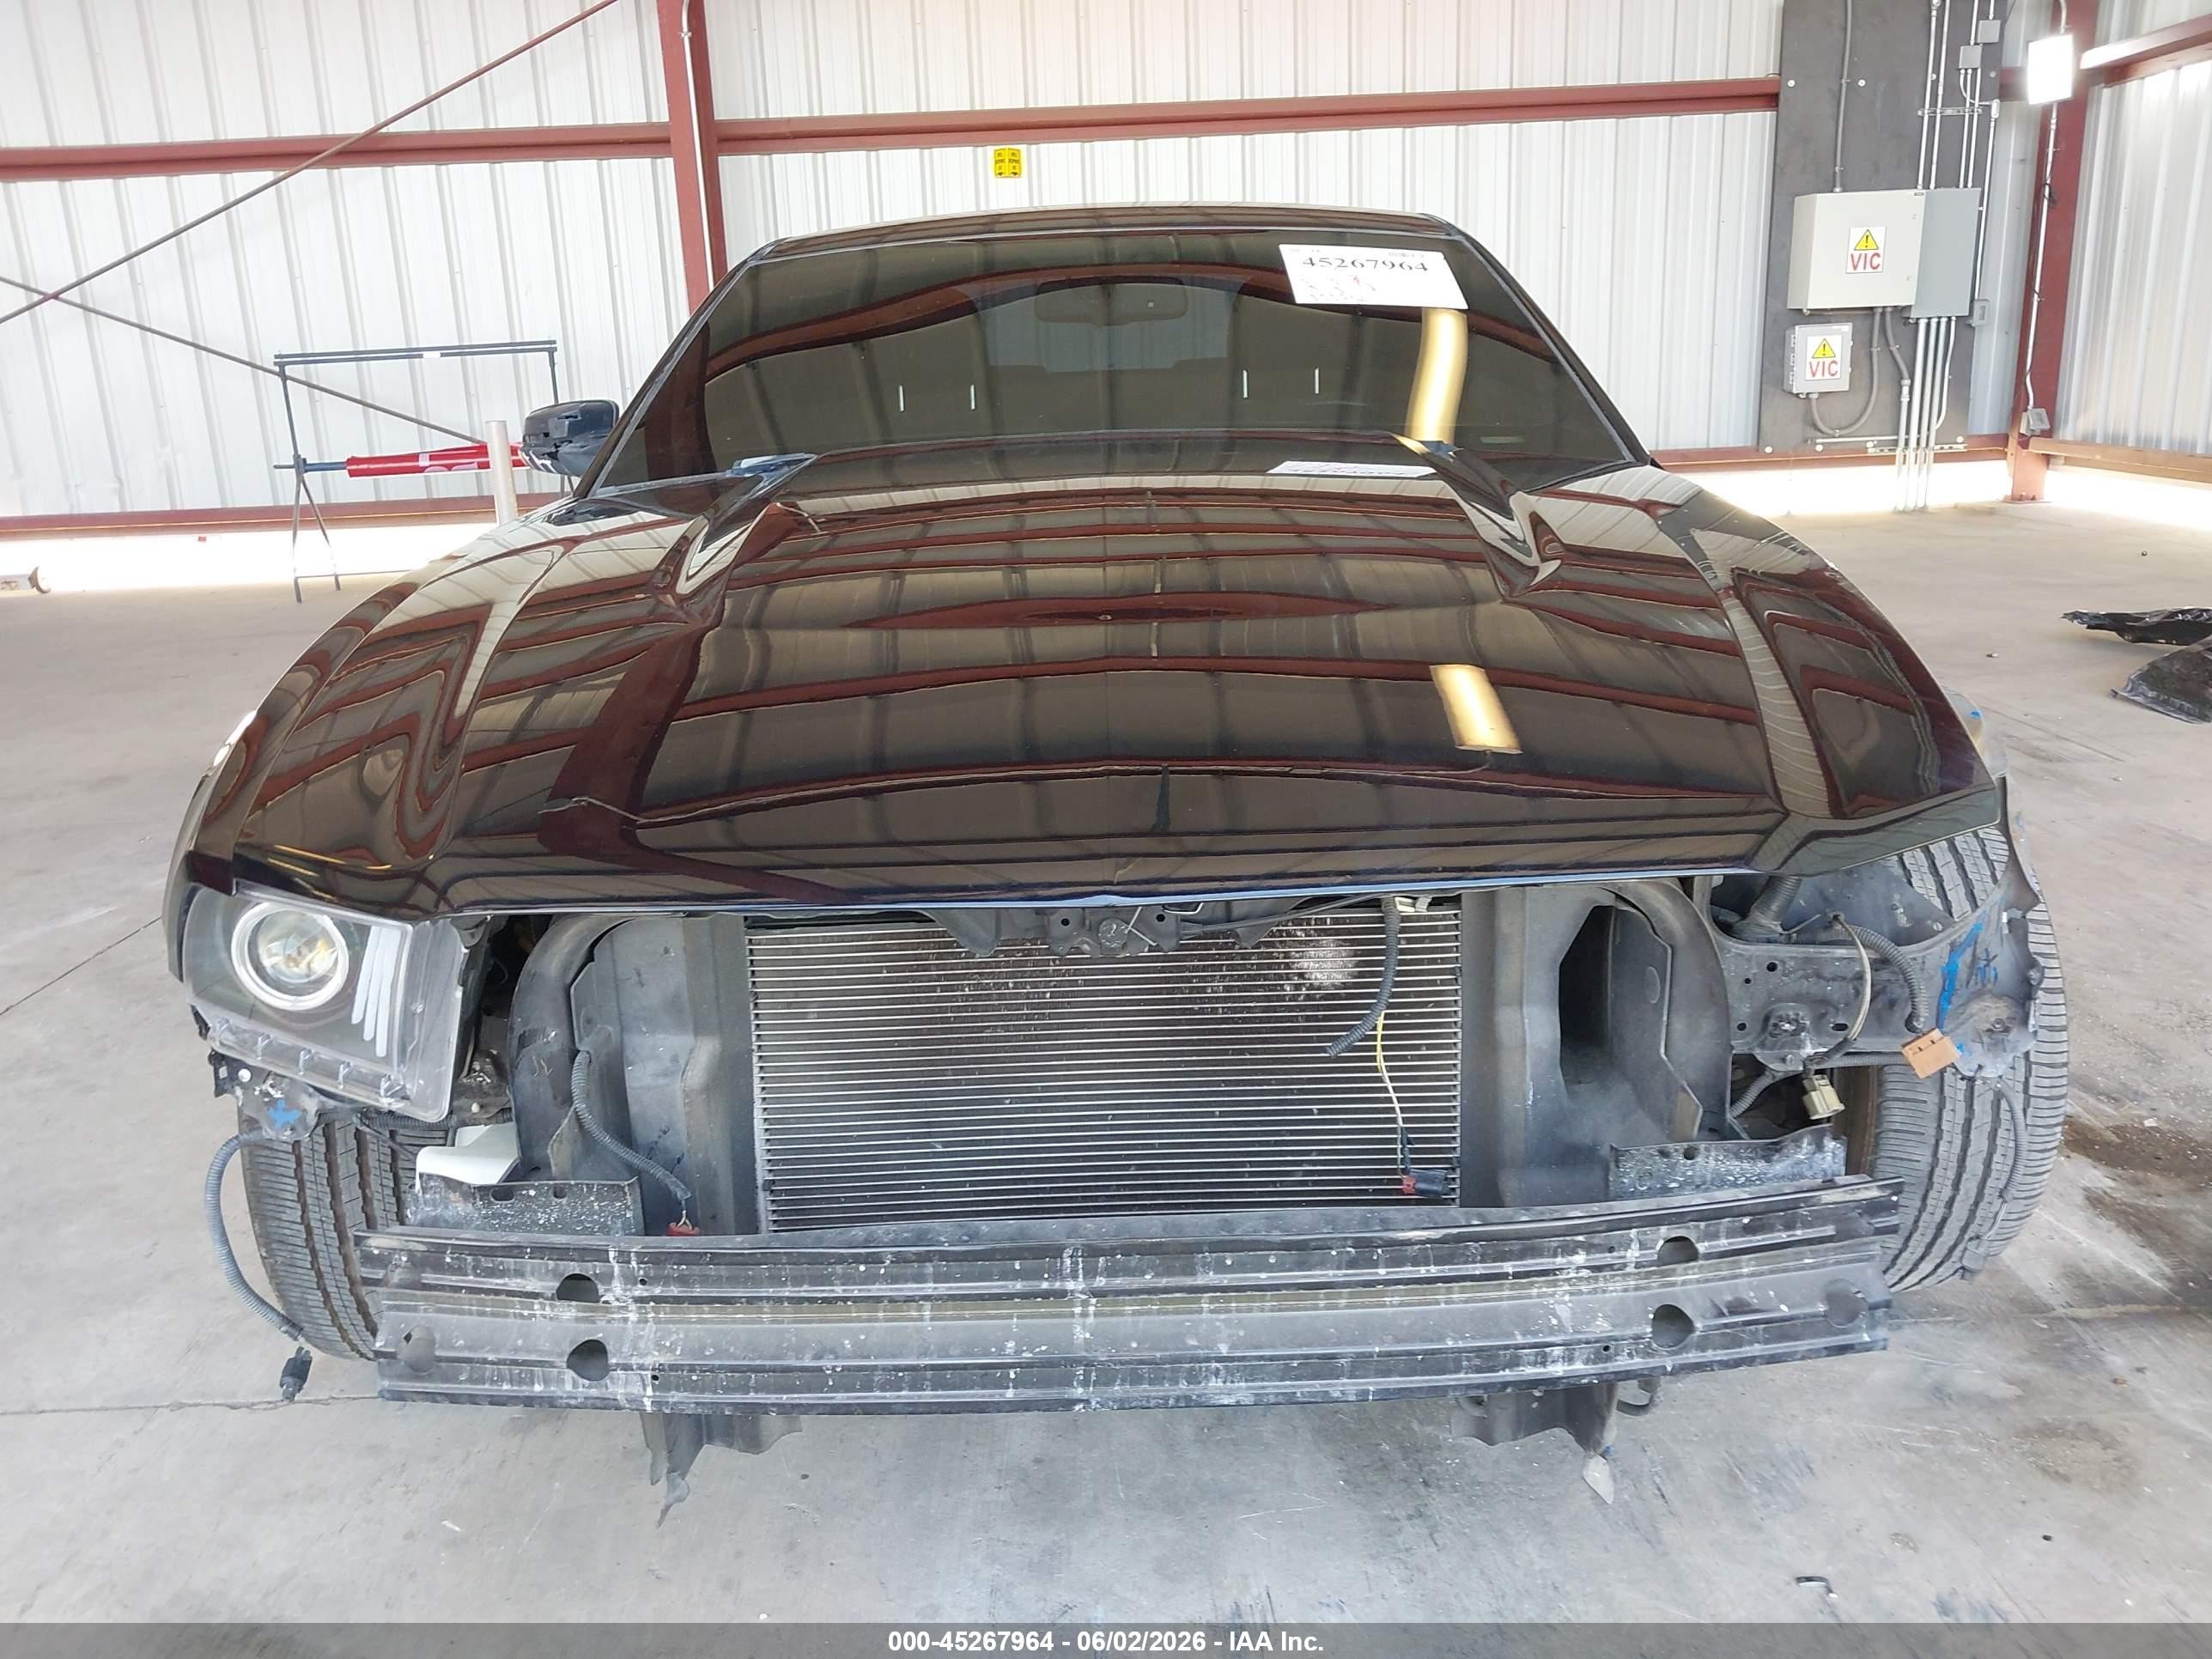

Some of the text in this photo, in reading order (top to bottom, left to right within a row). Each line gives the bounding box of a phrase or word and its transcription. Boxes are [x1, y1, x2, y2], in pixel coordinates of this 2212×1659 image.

[1302, 257, 1429, 272] 45267964
[1850, 252, 1881, 270] VIC
[1809, 361, 1838, 378] VIC
